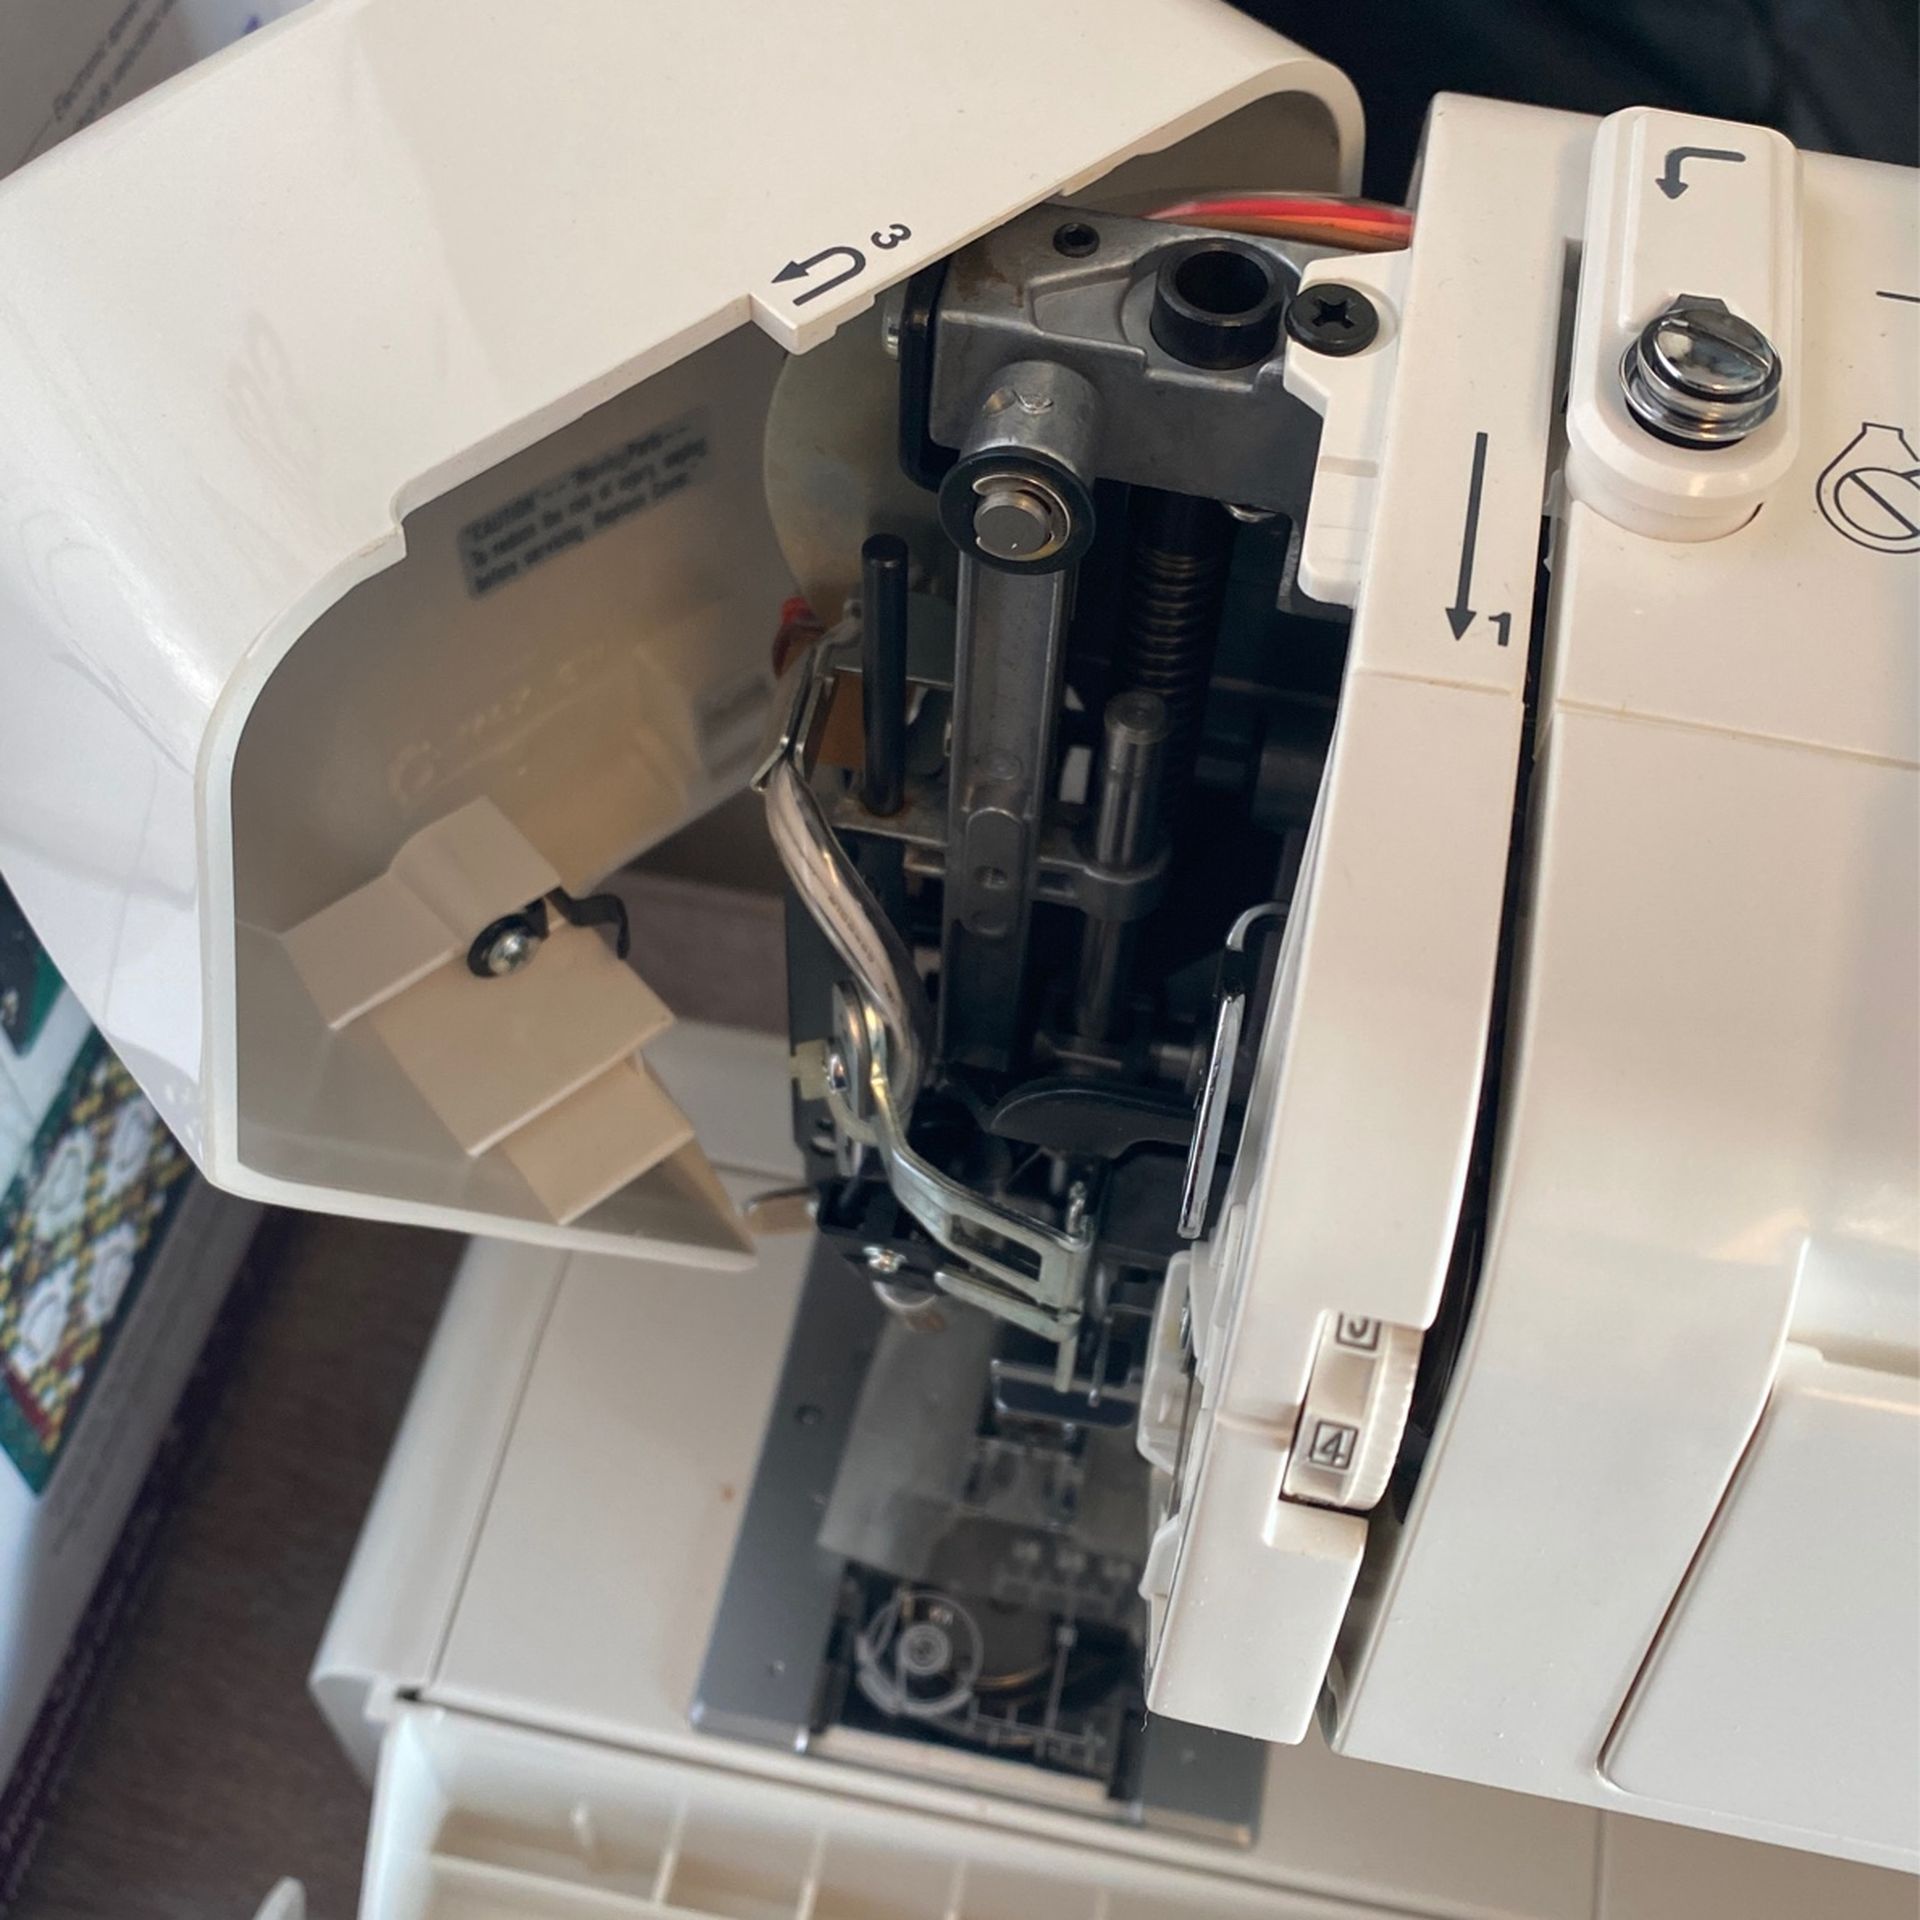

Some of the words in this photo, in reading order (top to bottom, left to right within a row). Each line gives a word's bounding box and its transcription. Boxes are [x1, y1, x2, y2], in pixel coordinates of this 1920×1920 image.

[871, 223, 912, 250] 3
[1488, 611, 1512, 647] 1
[1320, 1430, 1345, 1465] 4
